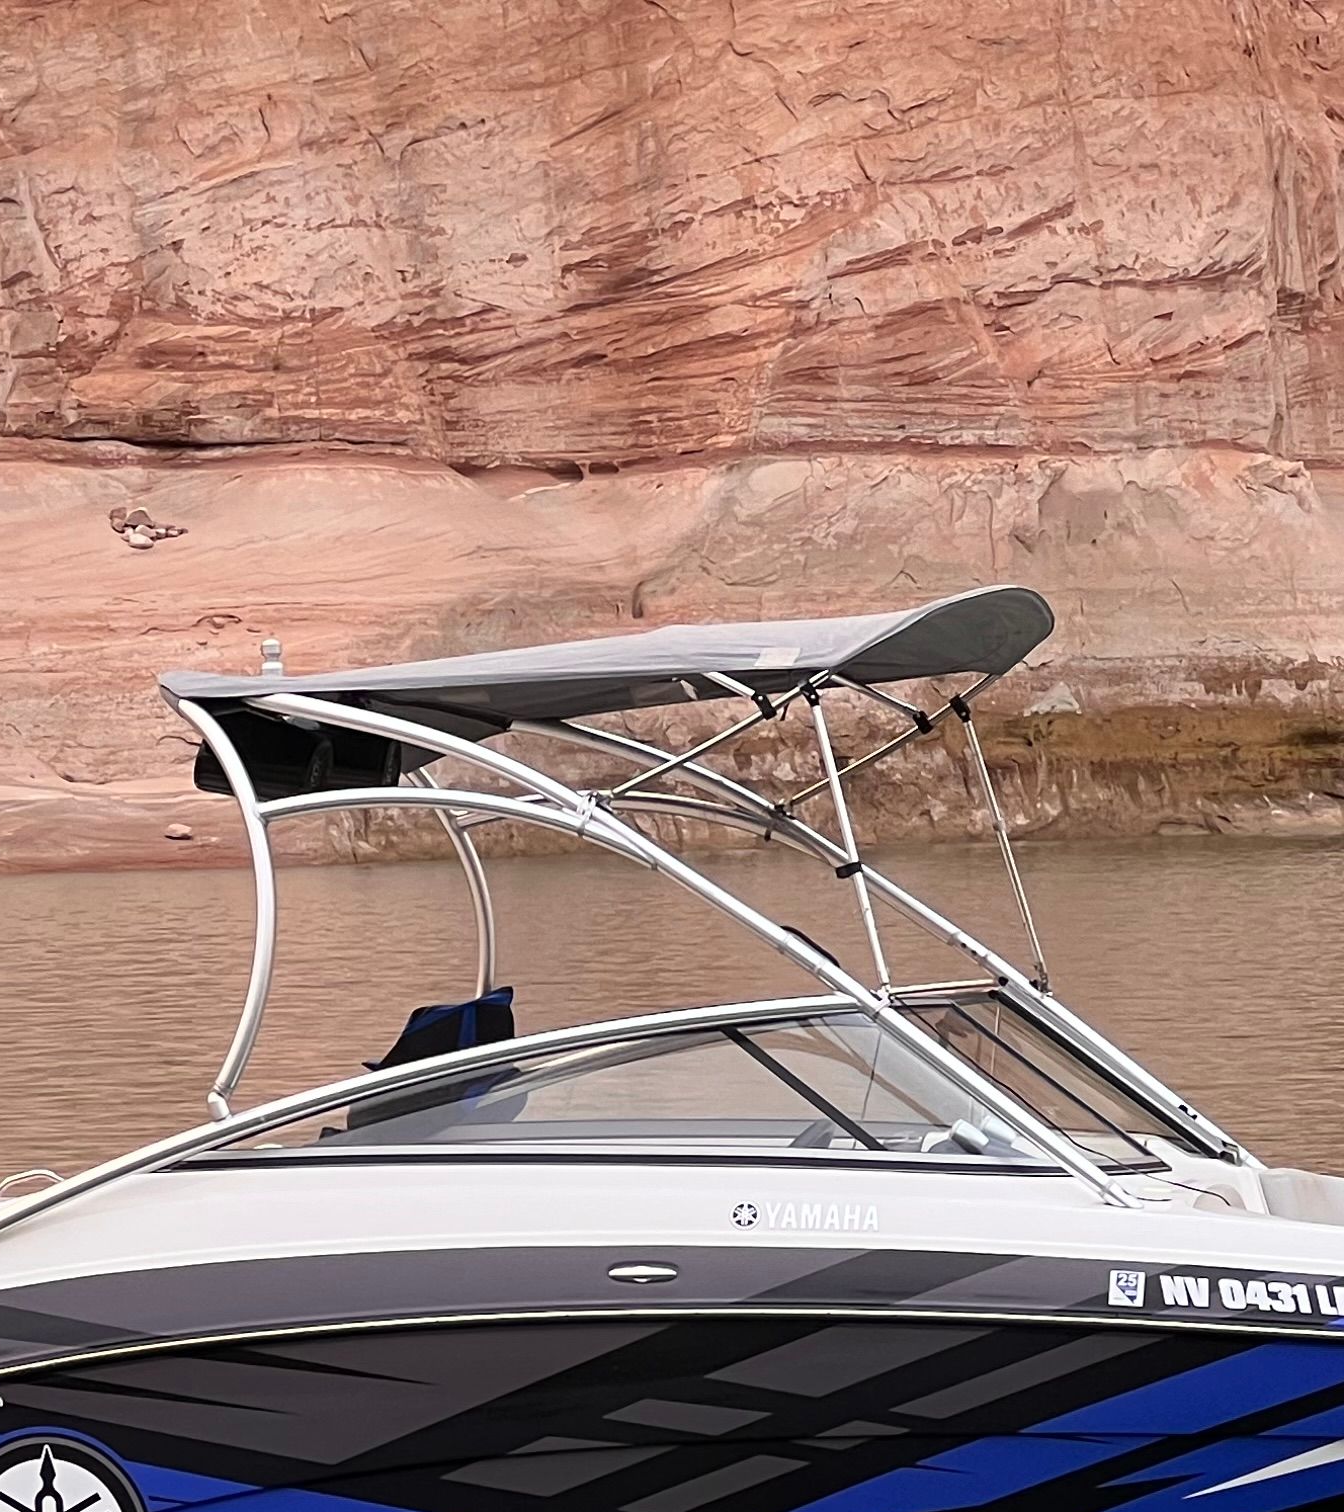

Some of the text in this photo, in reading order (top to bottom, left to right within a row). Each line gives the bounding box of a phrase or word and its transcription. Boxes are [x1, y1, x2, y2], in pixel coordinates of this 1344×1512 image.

[766, 1202, 879, 1231] YAMAHA
[1118, 1273, 1137, 1286] 25
[1159, 1275, 1209, 1307] NV
[1218, 1278, 1312, 1314] 0431
